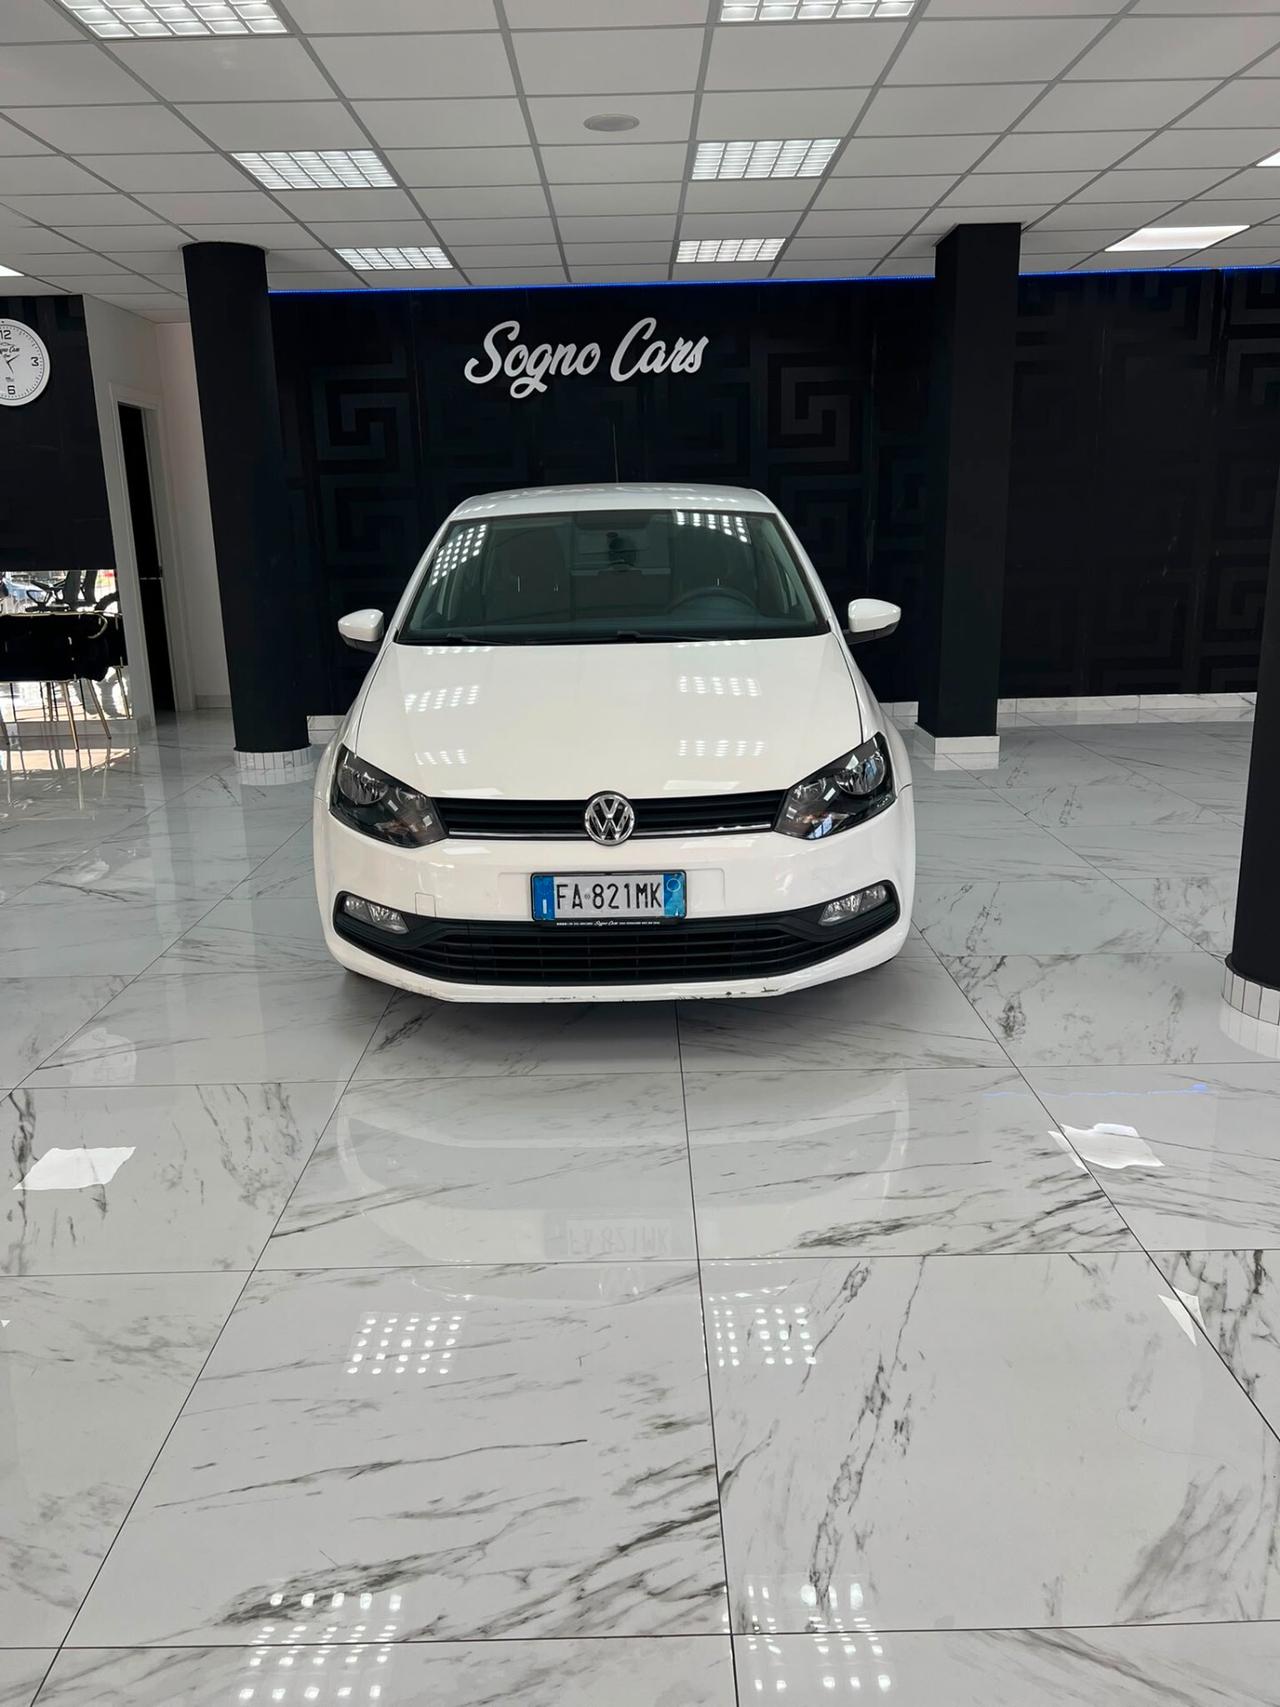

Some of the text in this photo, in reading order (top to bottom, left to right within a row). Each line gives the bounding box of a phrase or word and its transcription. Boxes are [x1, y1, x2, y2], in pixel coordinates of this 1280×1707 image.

[30, 356, 39, 367] 3
[464, 317, 710, 399] Sogno Cars
[7, 385, 16, 395] 6
